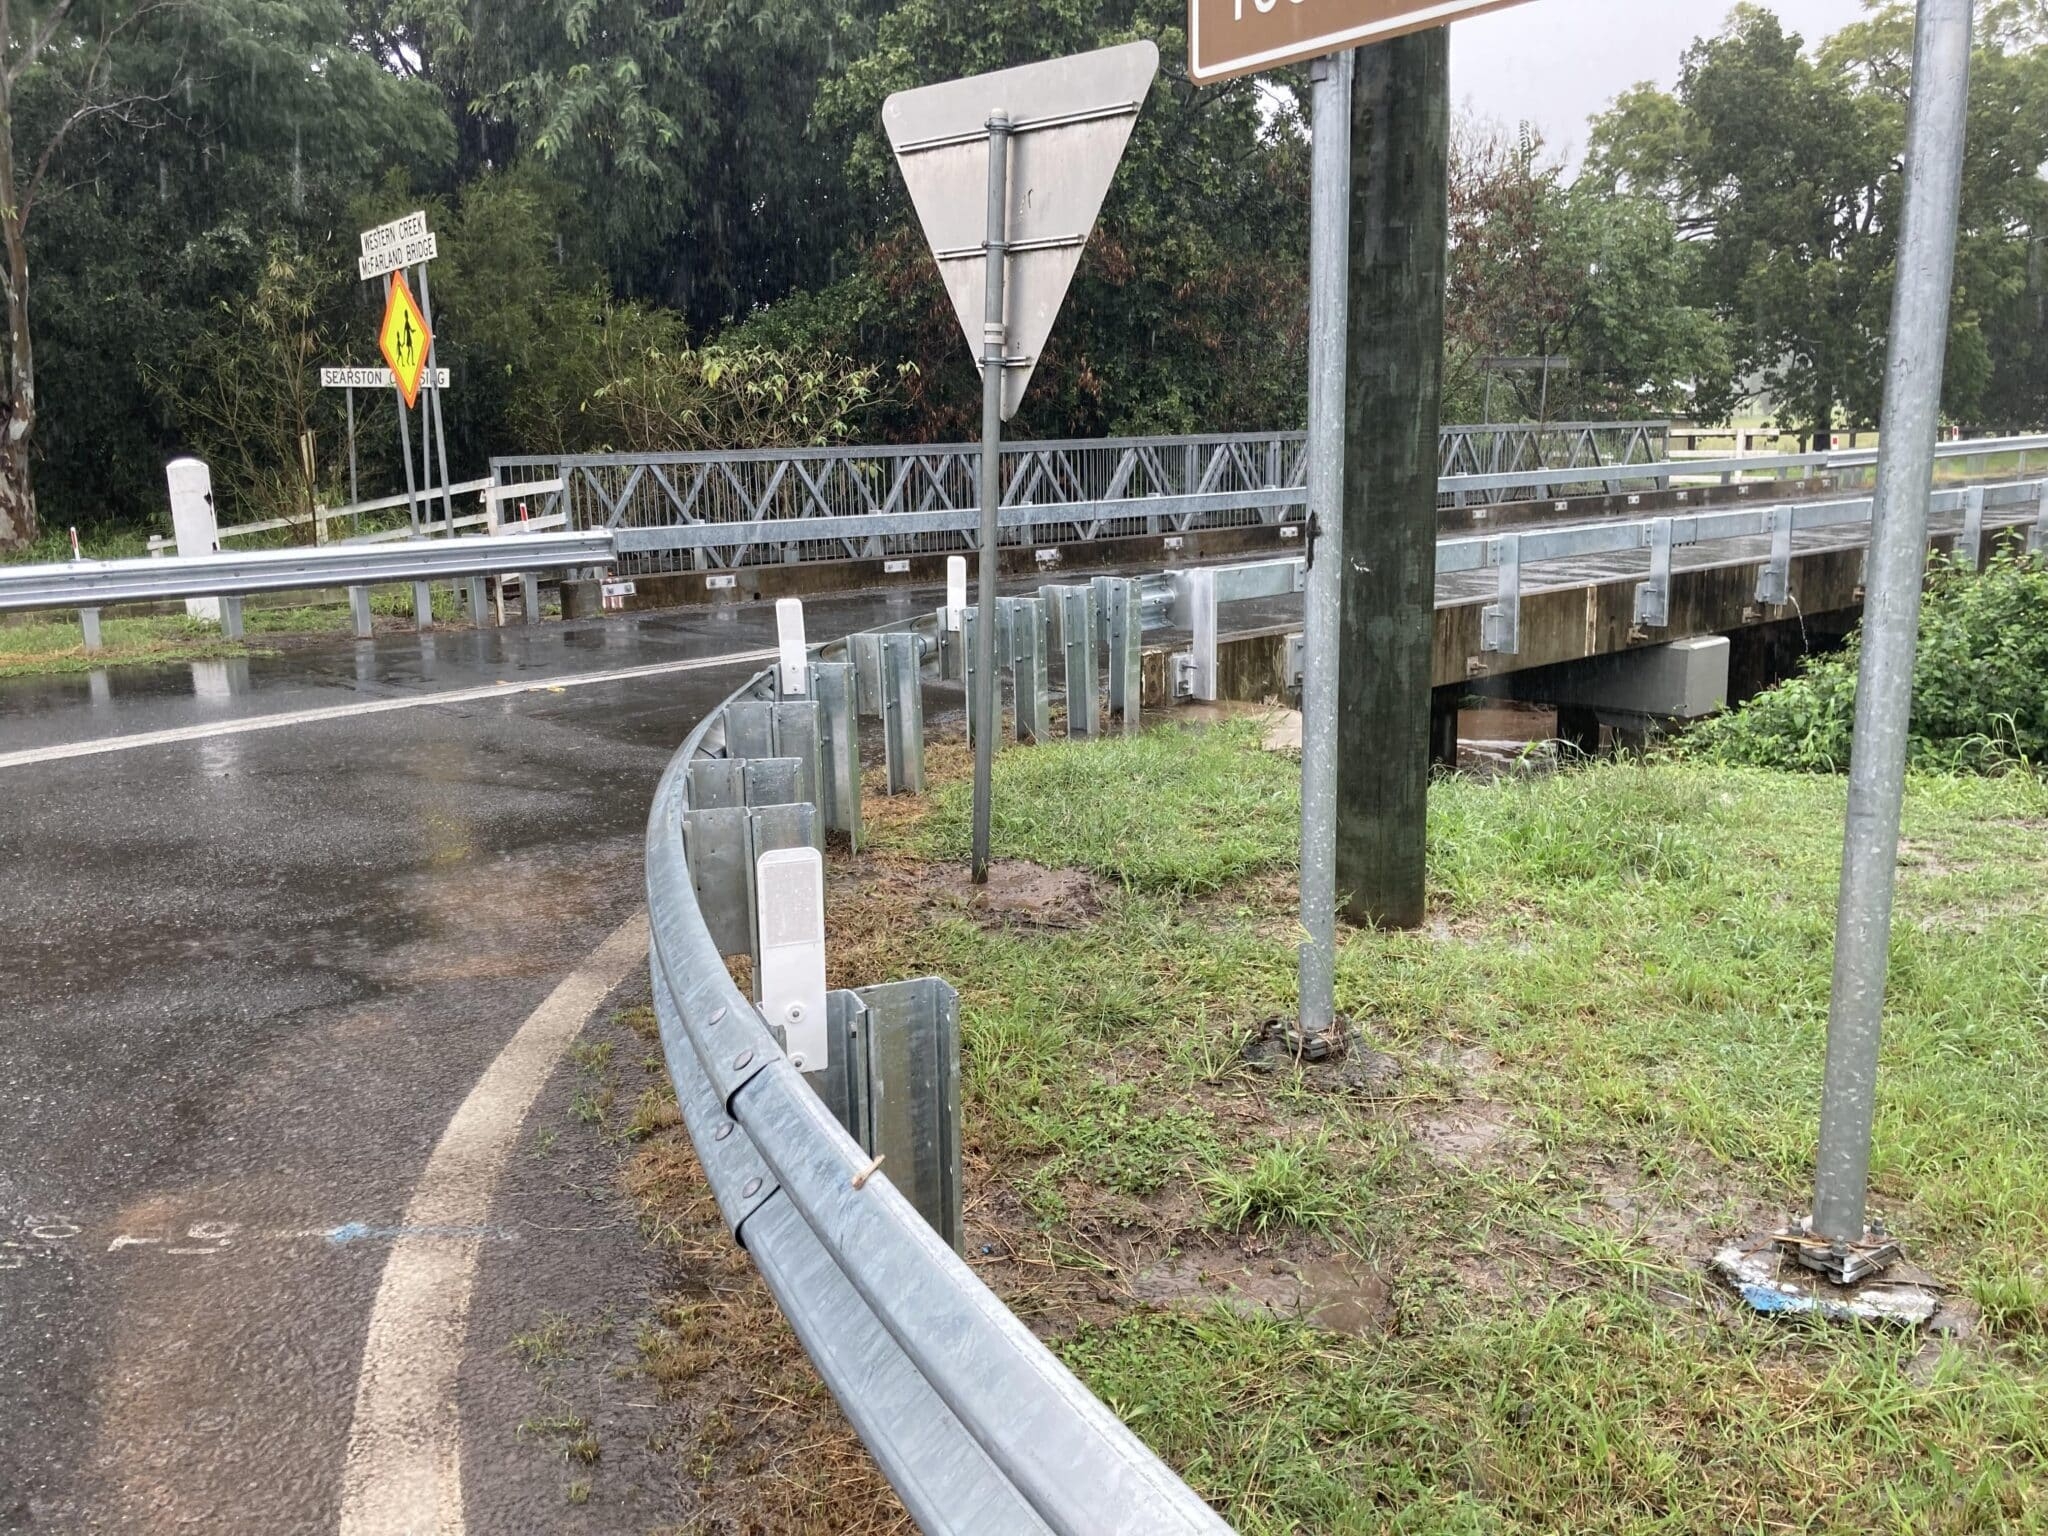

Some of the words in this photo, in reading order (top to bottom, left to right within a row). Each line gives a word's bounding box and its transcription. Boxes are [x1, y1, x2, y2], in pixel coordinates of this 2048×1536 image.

[364, 226, 396, 252] WESTERN
[398, 216, 424, 240] CREEK
[361, 247, 403, 276] McFARLAND
[406, 237, 434, 262] BRIDGE
[325, 371, 382, 385] SEARSTON
[390, 371, 445, 385] CSIG
